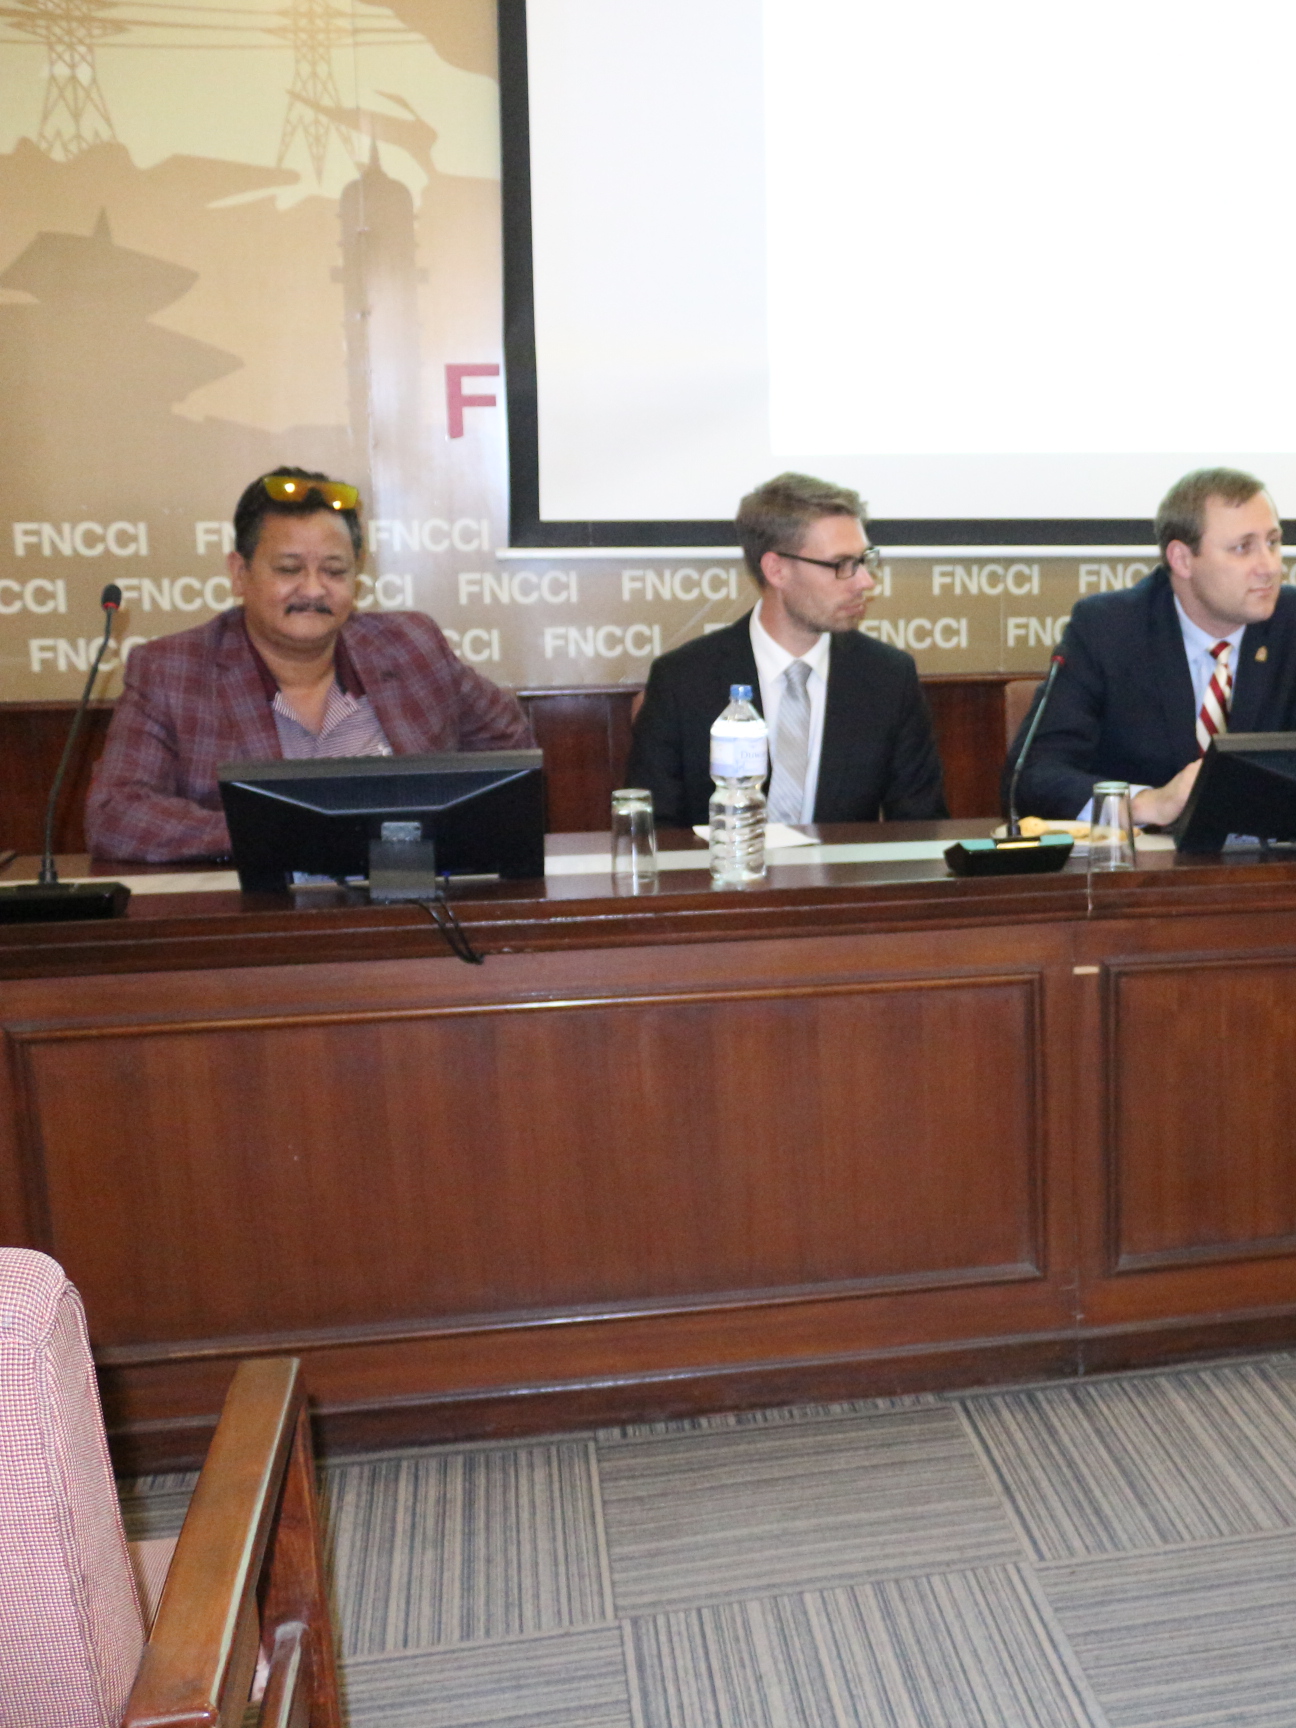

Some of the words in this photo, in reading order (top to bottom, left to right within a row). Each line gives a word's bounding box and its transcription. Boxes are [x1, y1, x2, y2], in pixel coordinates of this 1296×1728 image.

[13, 521, 149, 557] FNCCI
[367, 518, 490, 553] FNCCI
[115, 576, 243, 612] FNCC
[457, 570, 579, 605] FNCCI
[621, 567, 738, 601] FNCCI
[932, 563, 1040, 595] FNCCI
[1079, 562, 1162, 594] FNC
[544, 624, 661, 659] FNCCI
[858, 616, 968, 649] FNCCI
